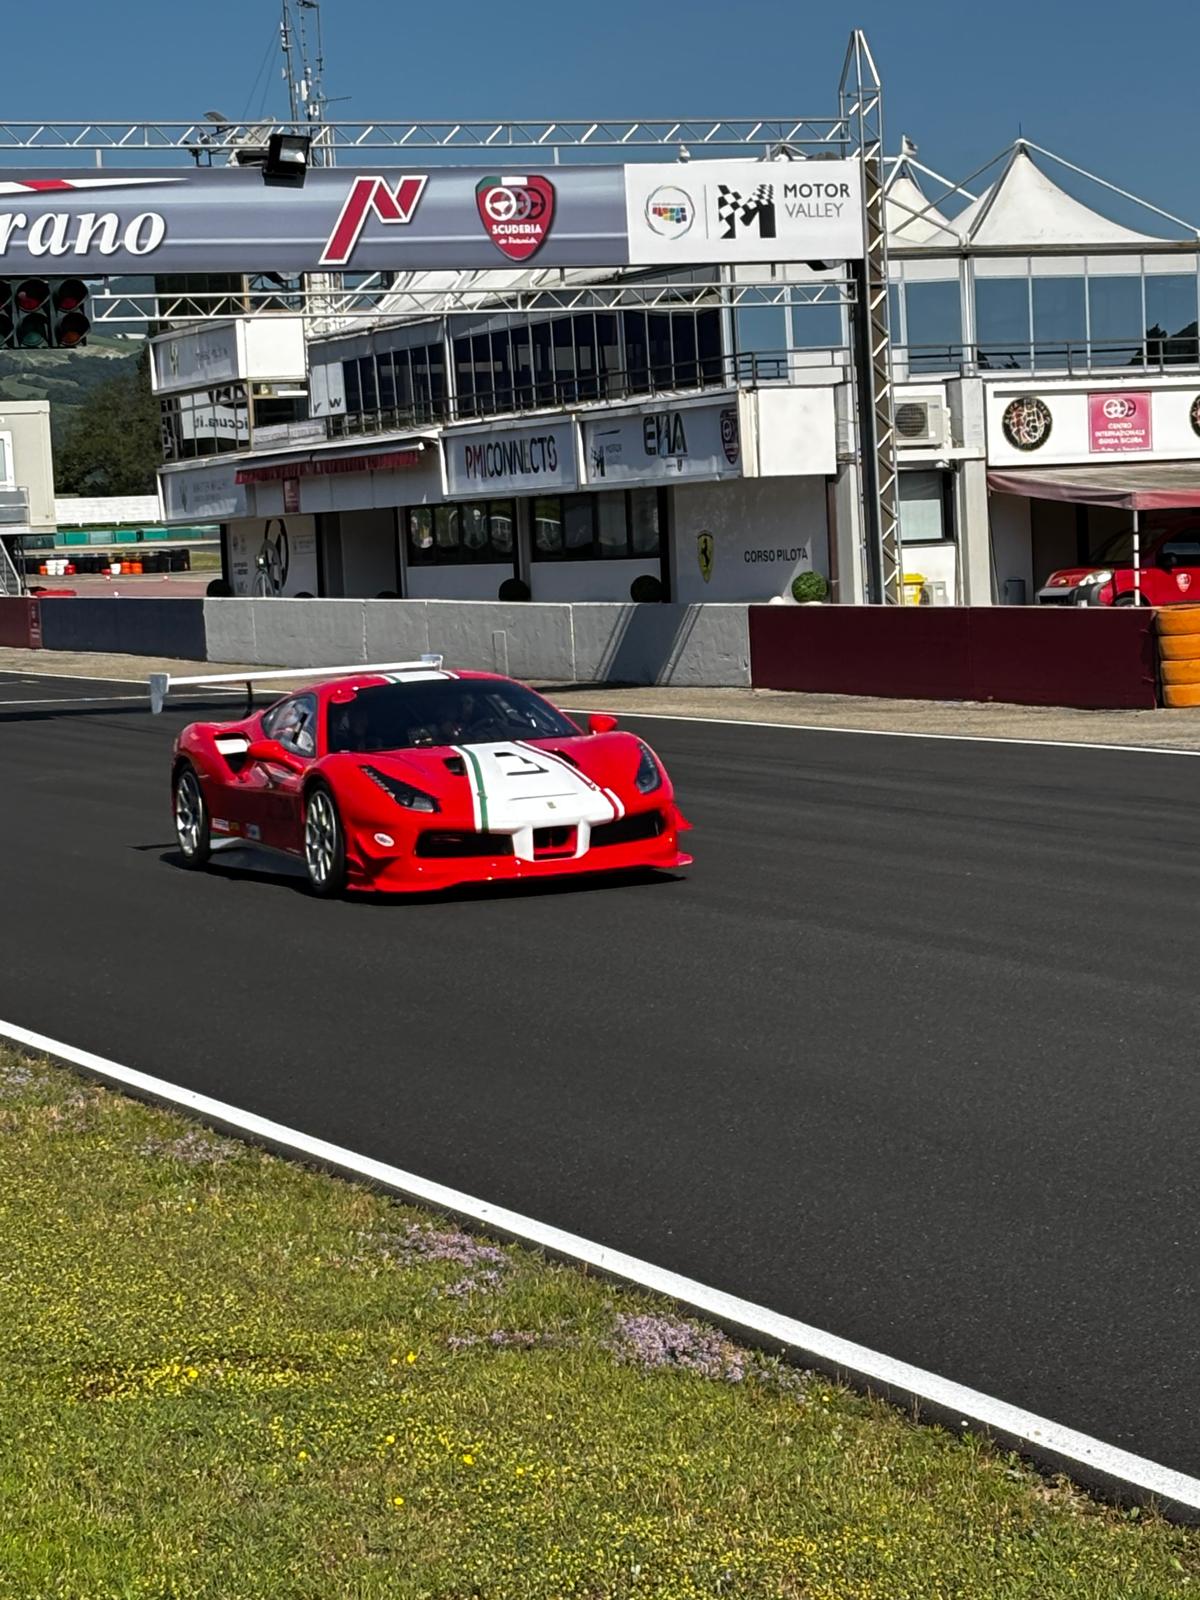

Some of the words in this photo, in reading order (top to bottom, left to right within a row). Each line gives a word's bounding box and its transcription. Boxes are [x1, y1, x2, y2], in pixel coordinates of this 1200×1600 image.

[784, 183, 851, 198] MOTOR
[785, 202, 844, 218] VALLEY
[0, 211, 166, 256] rano
[492, 224, 542, 234] SCUDERIA
[744, 550, 775, 563] CORSO
[776, 547, 808, 561] PILOTA
